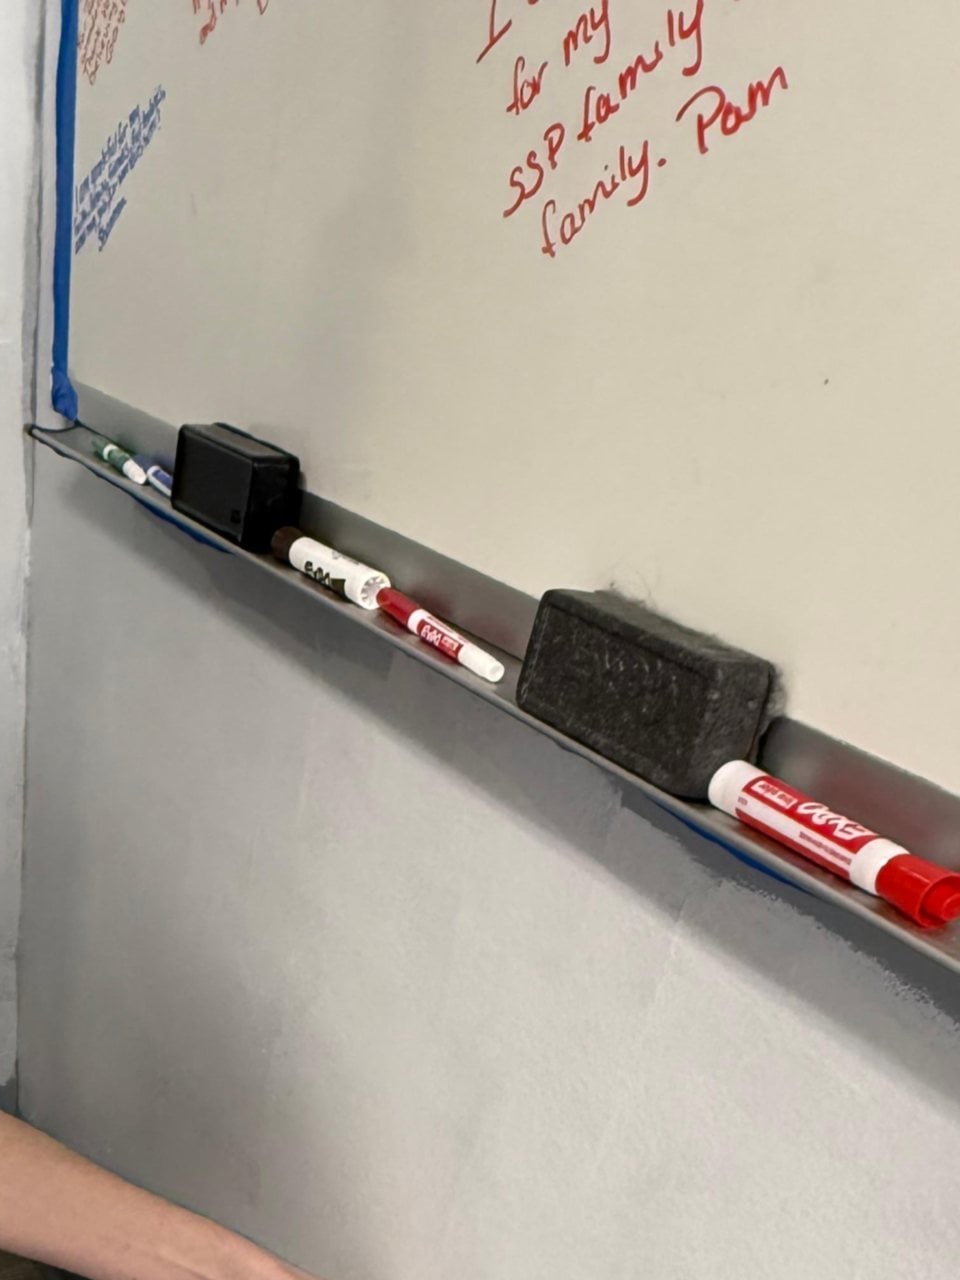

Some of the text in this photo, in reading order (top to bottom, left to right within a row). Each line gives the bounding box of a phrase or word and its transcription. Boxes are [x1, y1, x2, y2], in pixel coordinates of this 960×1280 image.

[506, 0, 611, 116] for my
[577, 0, 704, 142] family
[675, 66, 788, 154] Pam
